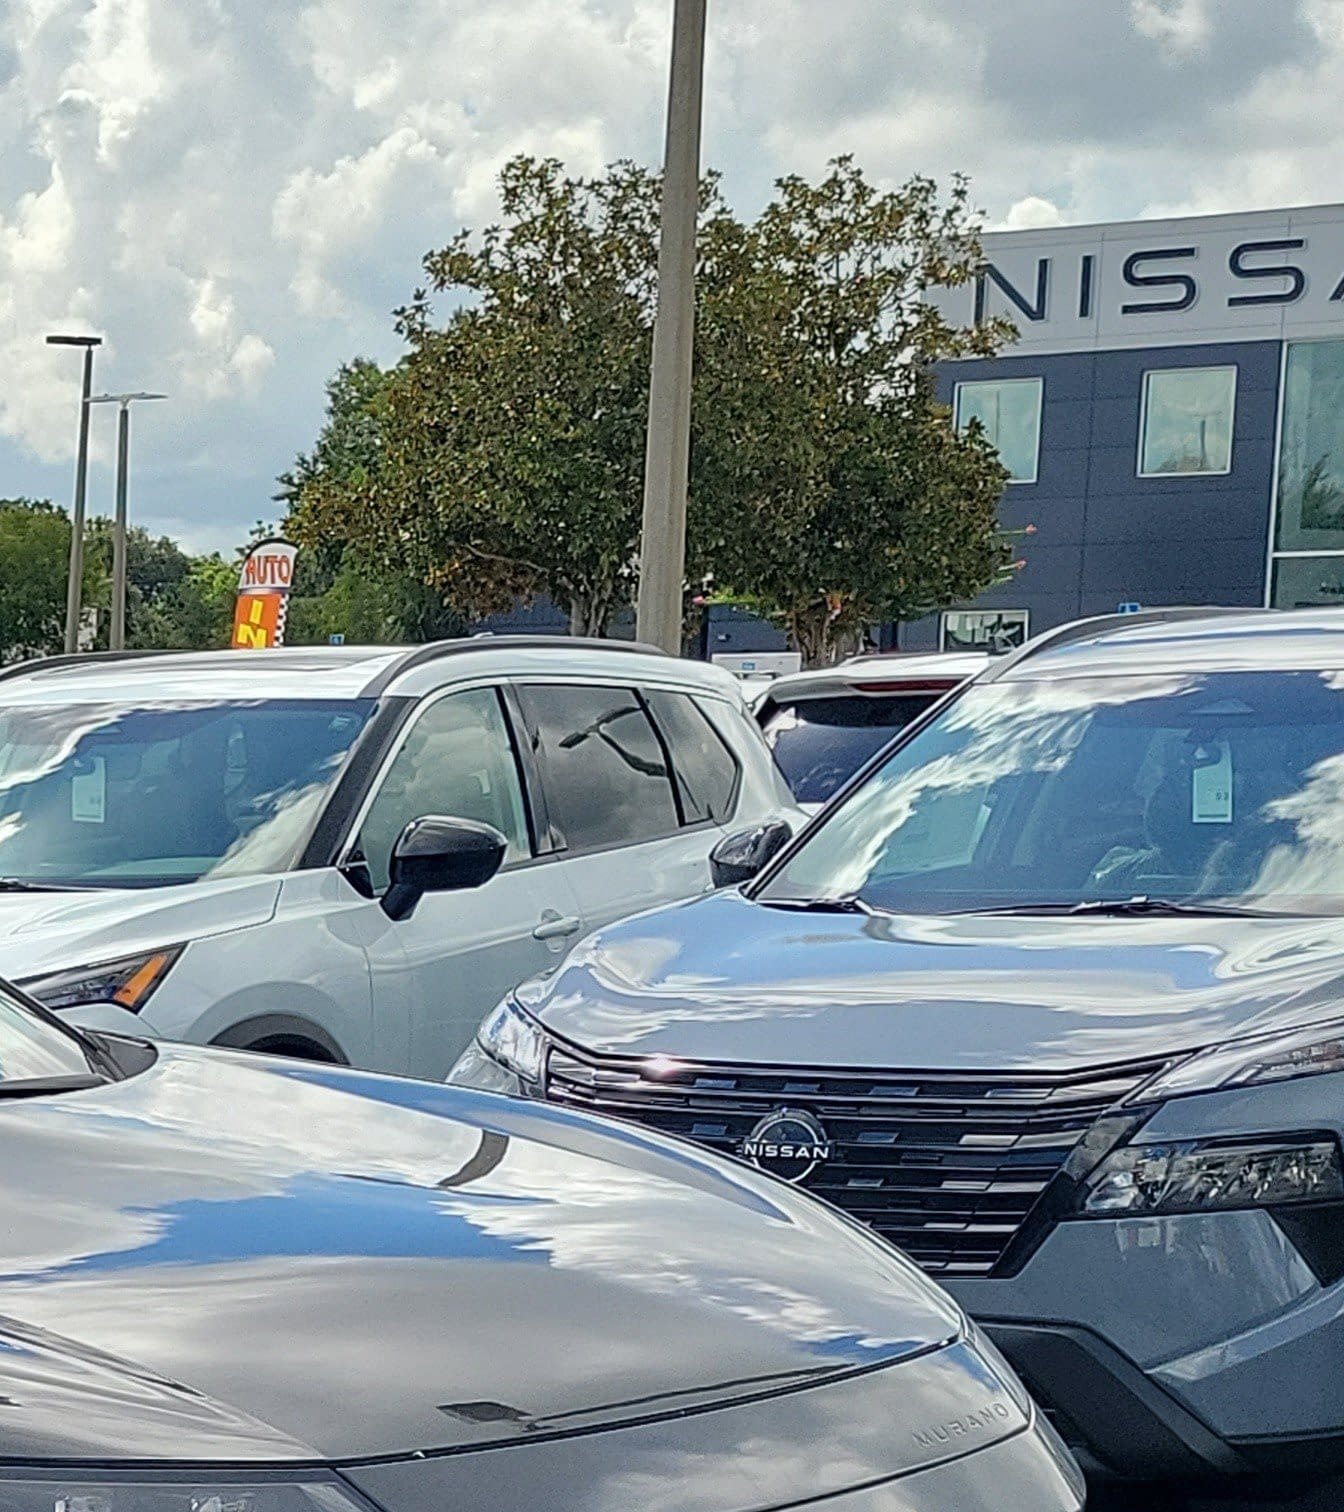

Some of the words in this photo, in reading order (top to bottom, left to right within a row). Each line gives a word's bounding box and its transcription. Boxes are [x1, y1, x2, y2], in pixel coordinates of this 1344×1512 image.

[973, 238, 1344, 326] NISS
[245, 554, 291, 585] AUTO
[744, 1143, 829, 1159] NISSAN
[912, 1403, 1010, 1449] MURANO
